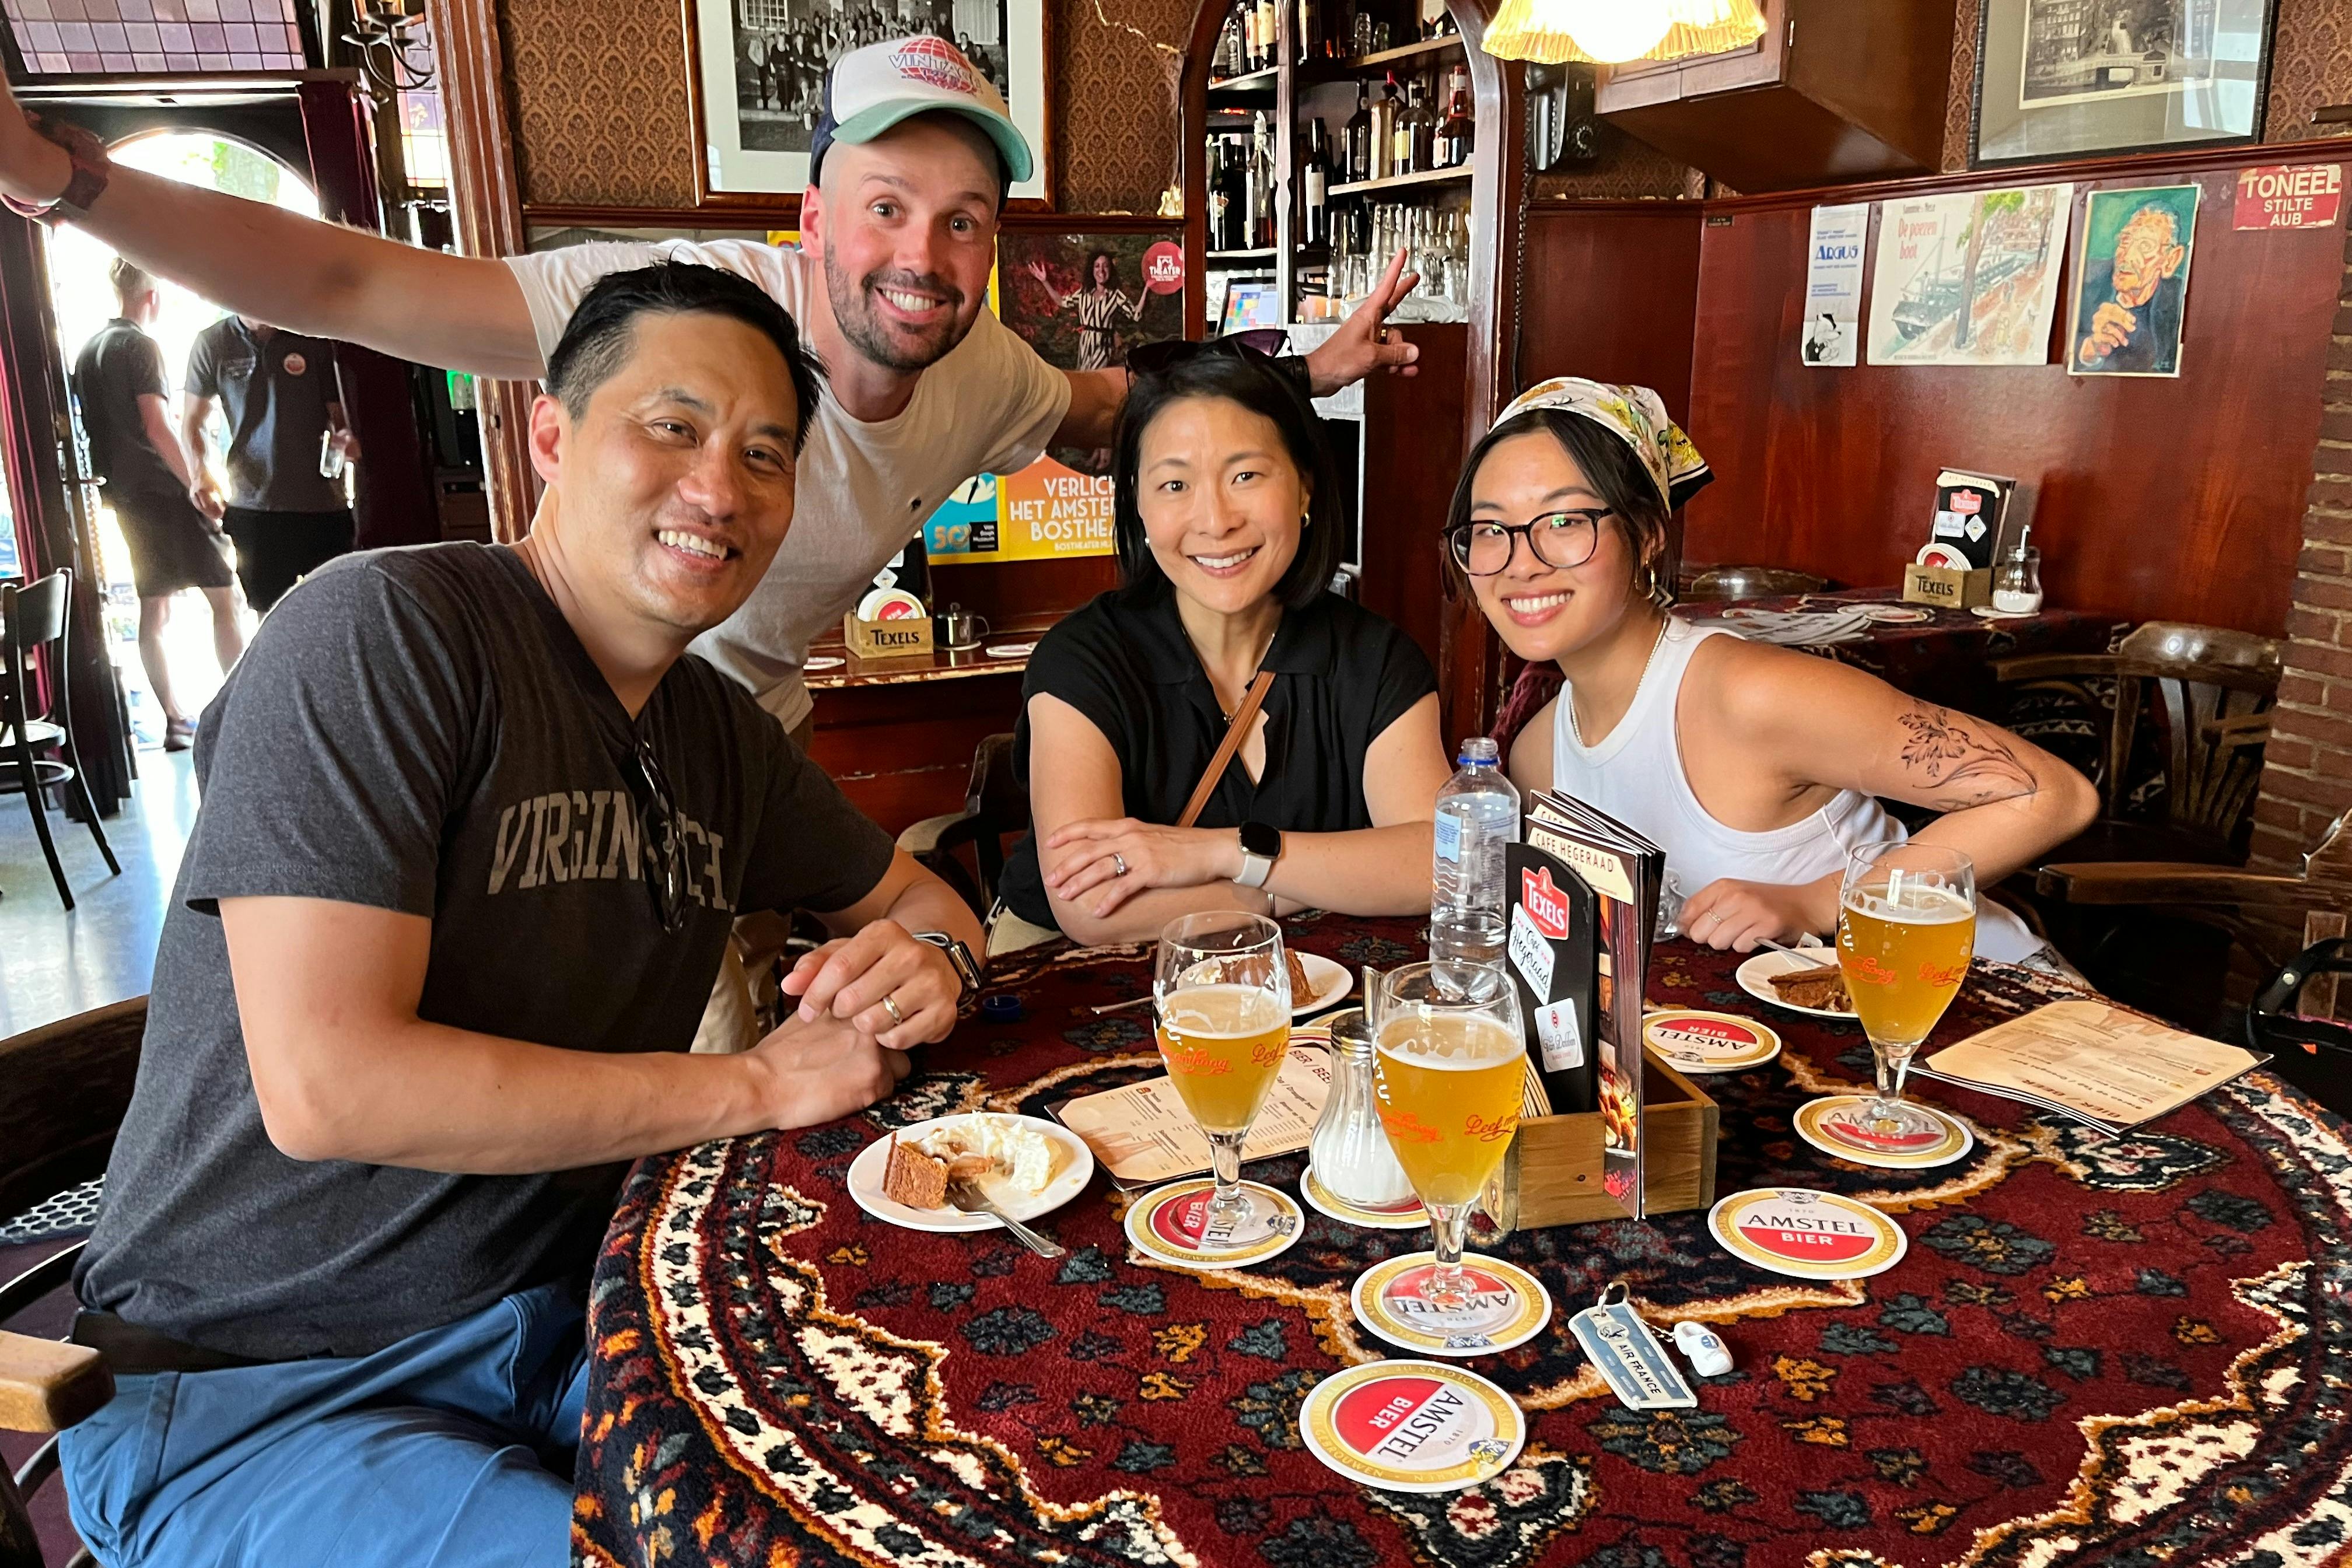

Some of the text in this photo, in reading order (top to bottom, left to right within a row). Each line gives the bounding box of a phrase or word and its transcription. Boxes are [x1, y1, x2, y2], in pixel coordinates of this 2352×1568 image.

[2246, 172, 2339, 198] TONEEL
[2263, 198, 2314, 213] STILTE
[2270, 213, 2302, 226] AUB
[1815, 246, 1859, 260] ARGUS
[1010, 500, 1045, 521] HET
[1916, 575, 1954, 596] TEXELS
[870, 629, 920, 645] TEXELS
[1536, 833, 1614, 873] CAFE HEGERAAD
[1525, 877, 1566, 930] TEXELS
[1658, 1030, 1748, 1050] AMSTEL
[1687, 1026, 1728, 1037] BIER
[1183, 1202, 1204, 1228] BIER
[1748, 1214, 1865, 1235] AMSTEL
[1781, 1231, 1834, 1246] BIER
[1619, 1344, 1634, 1359] AIR
[1630, 1360, 1661, 1395] FRANCE
[1368, 1396, 1414, 1429] BIER
[1377, 1390, 1464, 1458] AMSTEL
[1446, 1429, 1463, 1446] 1870
